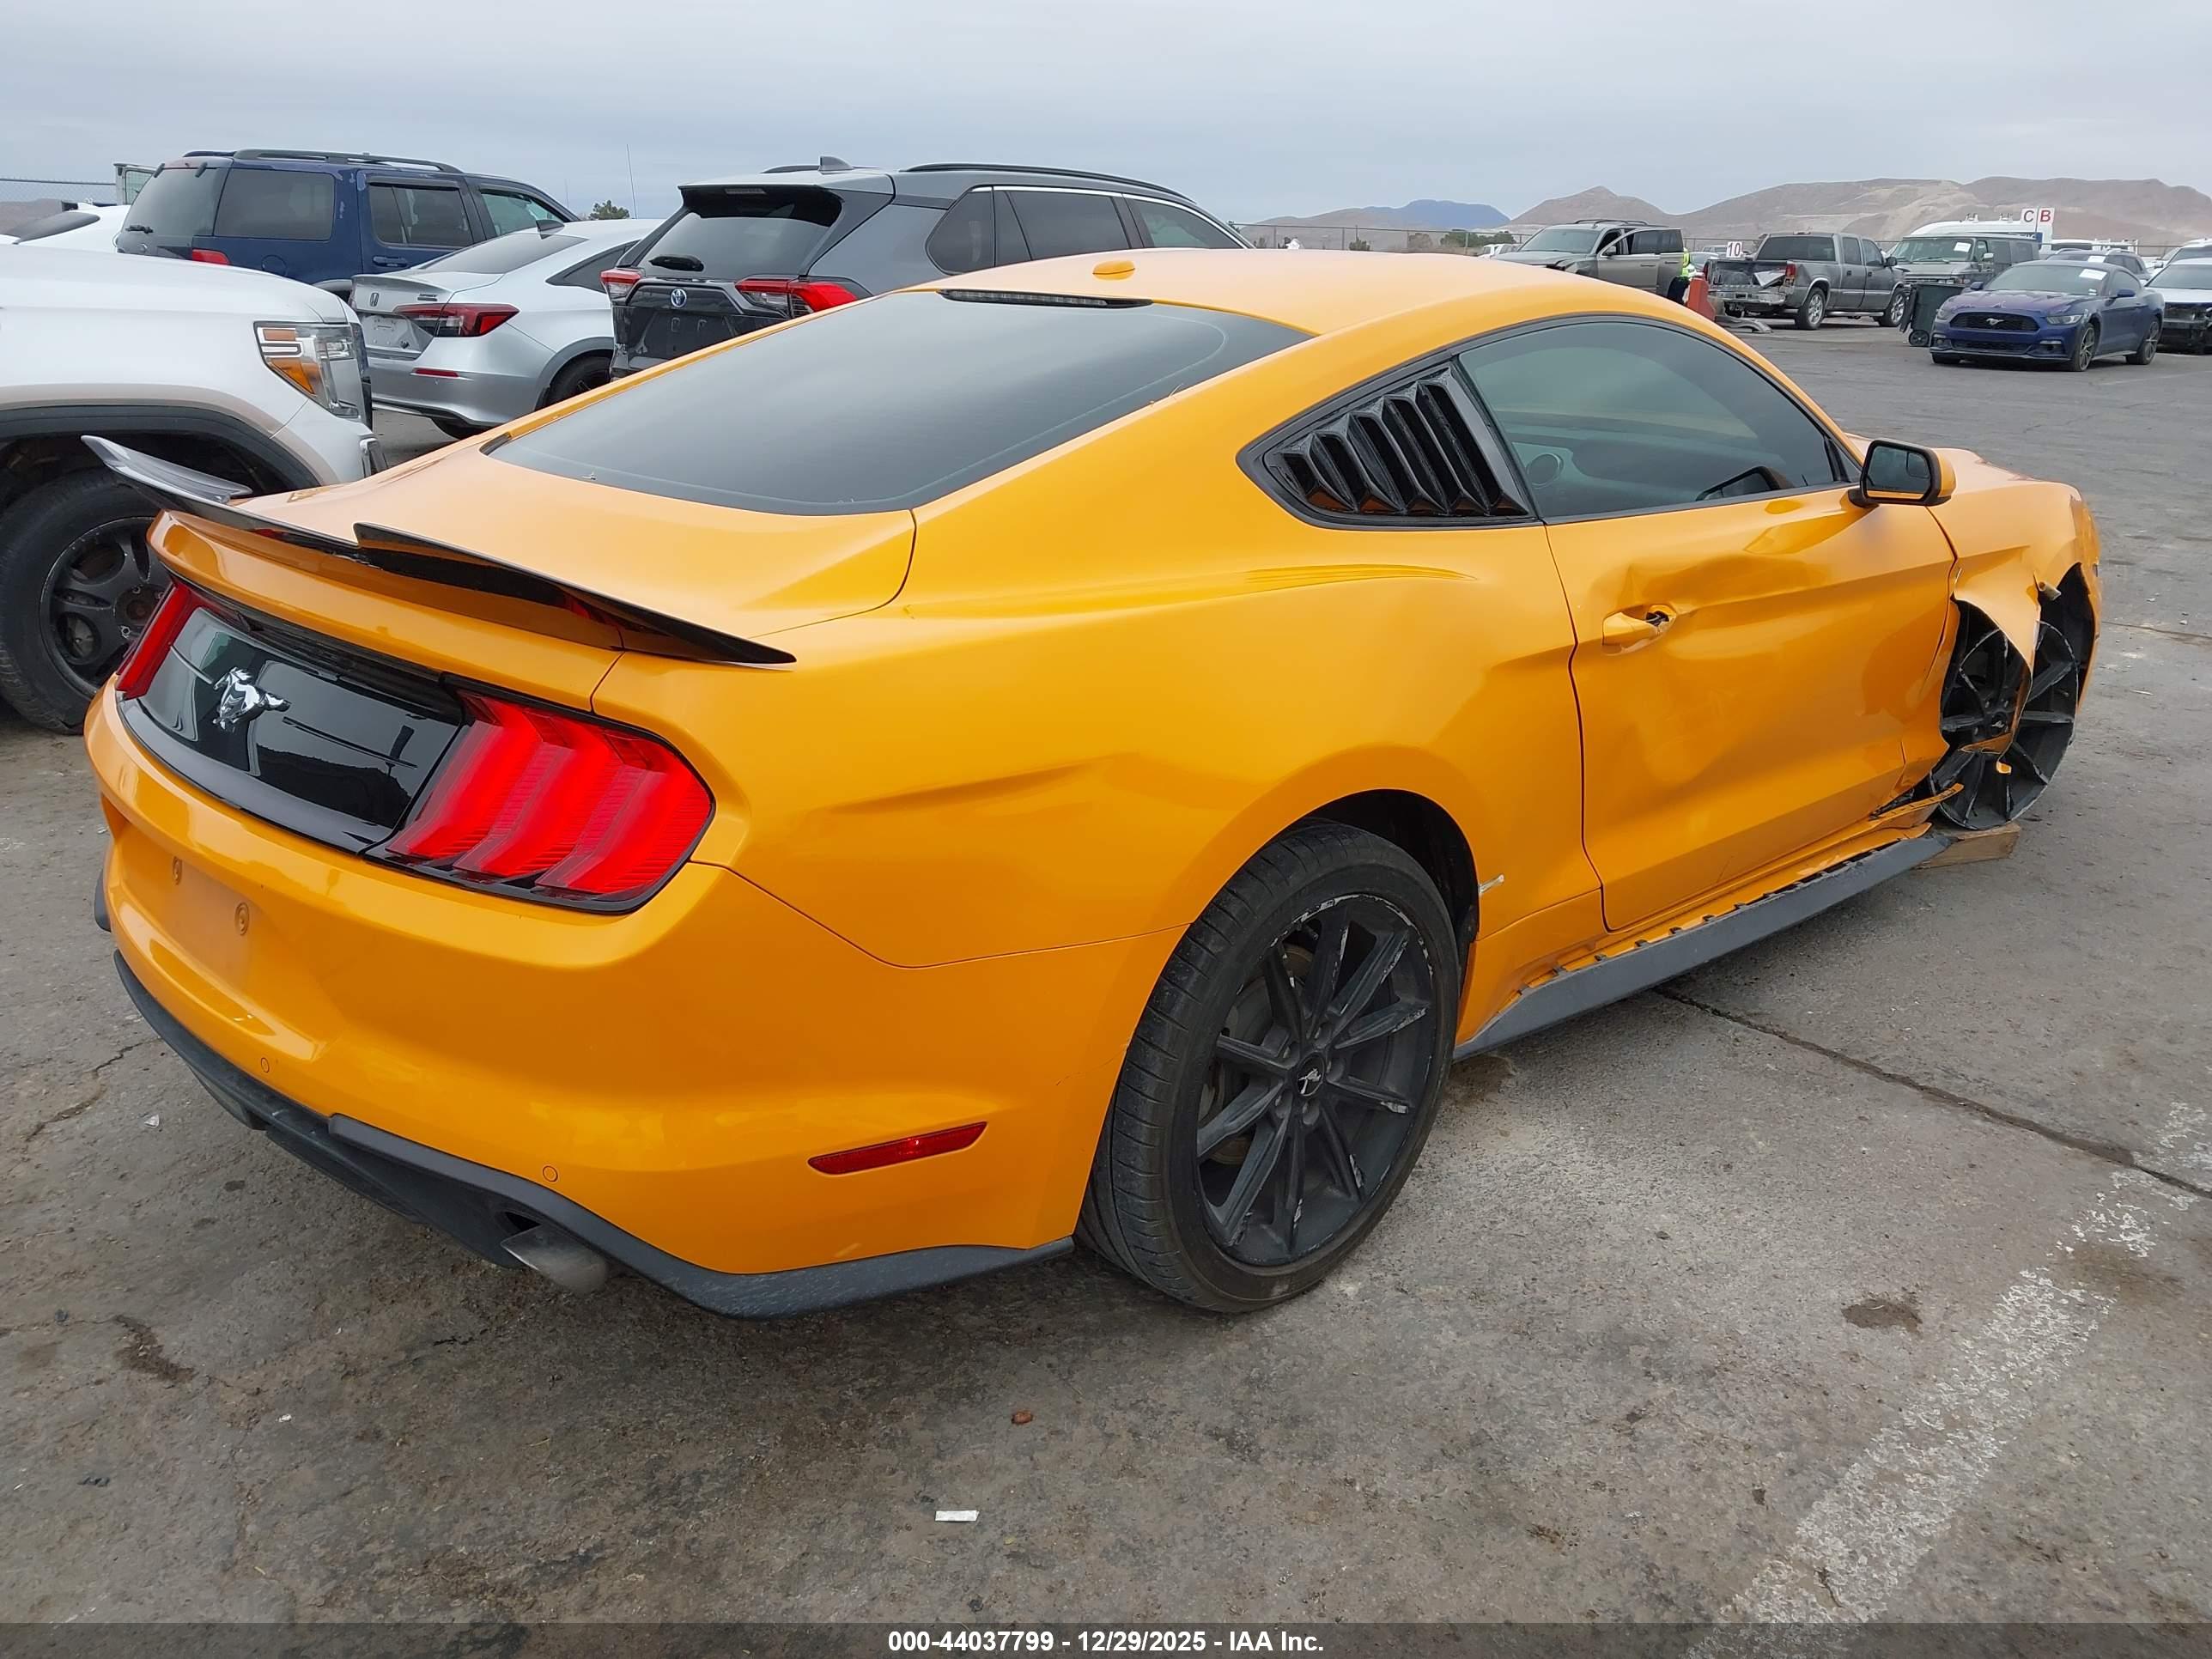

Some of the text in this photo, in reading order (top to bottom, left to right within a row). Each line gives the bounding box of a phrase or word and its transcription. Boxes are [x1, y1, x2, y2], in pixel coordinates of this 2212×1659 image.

[2023, 210, 2034, 223] C
[2039, 210, 2051, 222] B
[1728, 242, 1741, 257] 10
